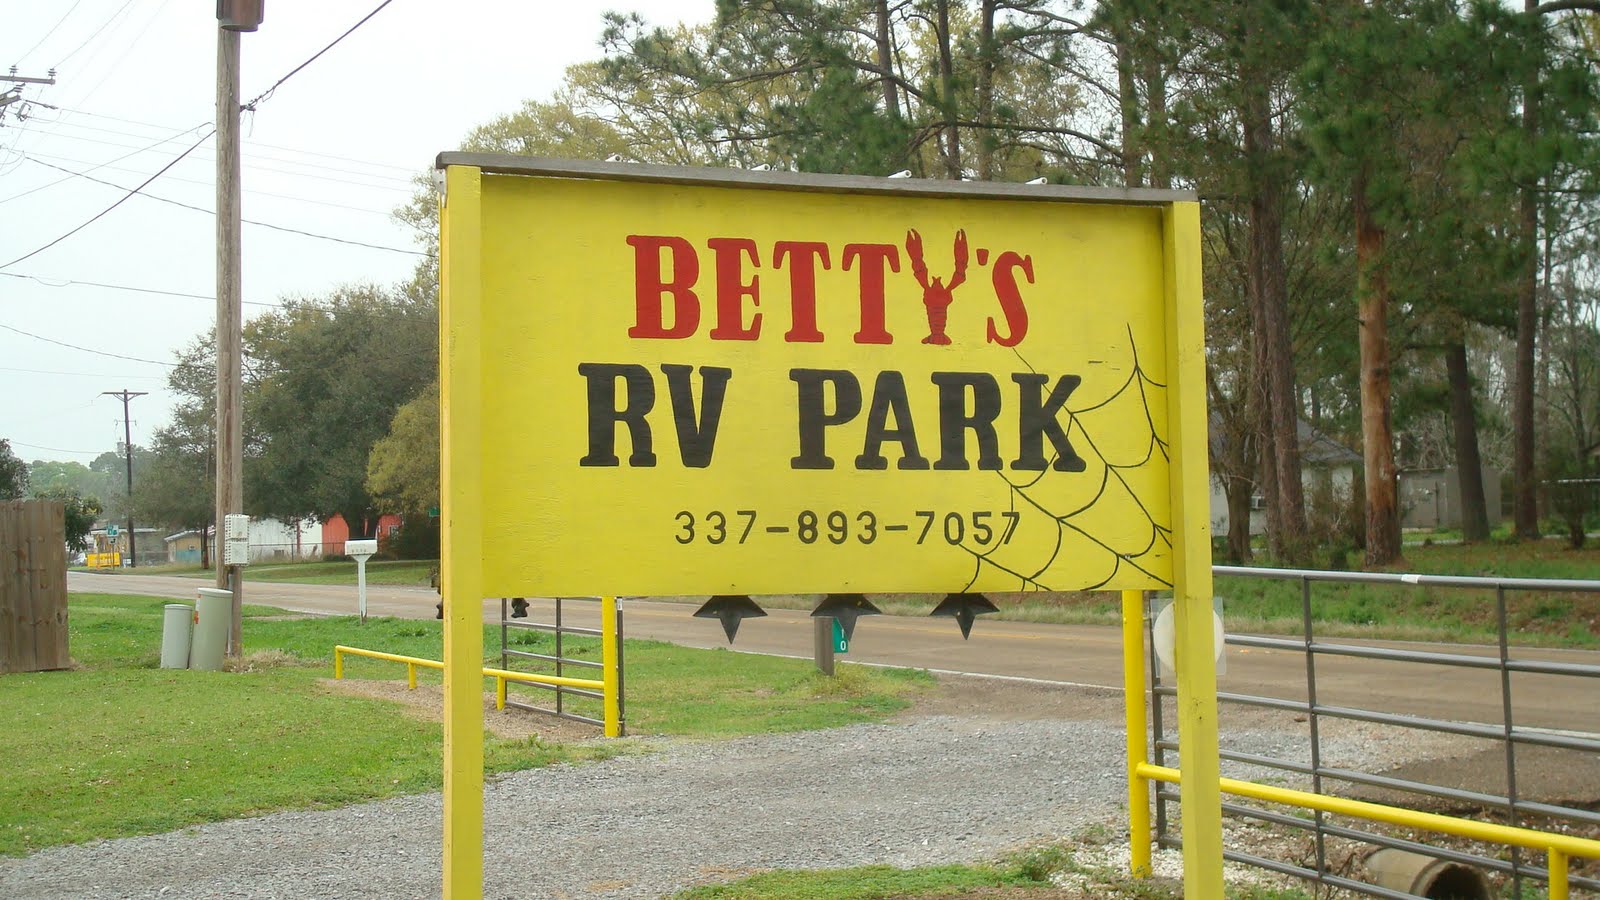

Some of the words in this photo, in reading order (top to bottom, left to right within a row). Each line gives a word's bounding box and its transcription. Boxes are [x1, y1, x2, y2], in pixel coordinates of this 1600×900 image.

[626, 228, 1035, 347] BETTY'S
[578, 362, 732, 468] RV
[789, 367, 1087, 472] PARK
[674, 510, 1021, 546] 337-893-7057
